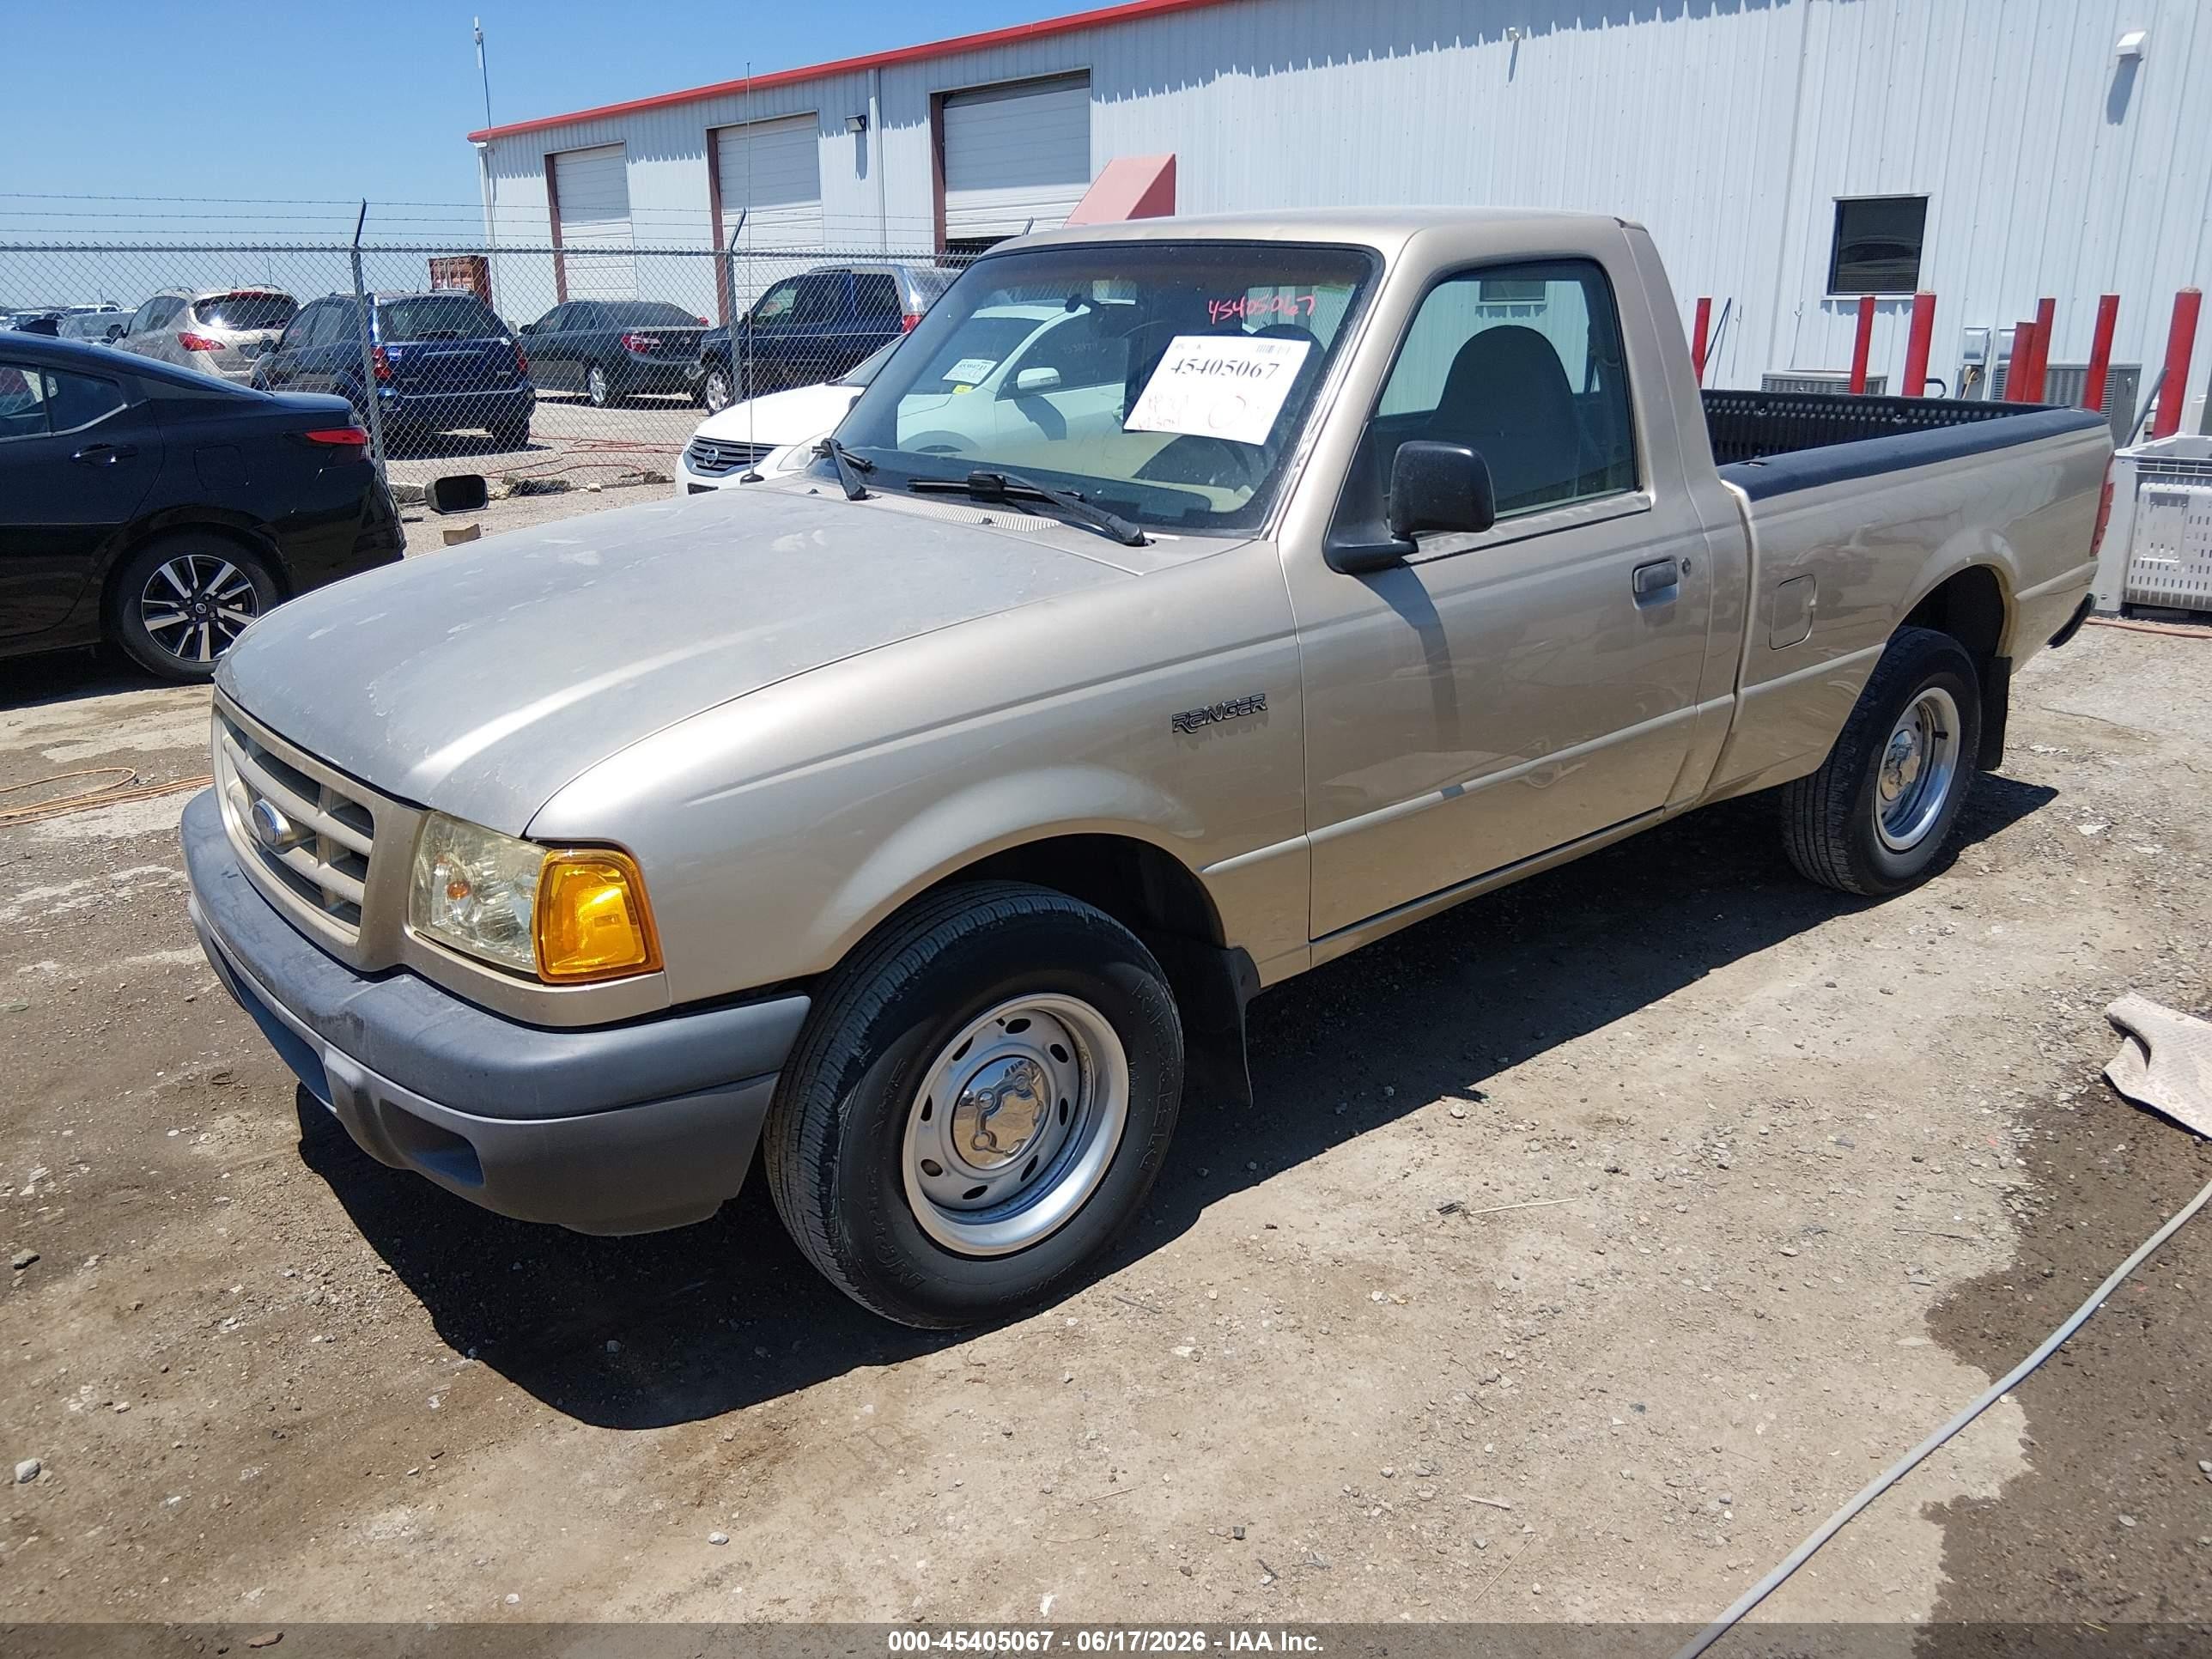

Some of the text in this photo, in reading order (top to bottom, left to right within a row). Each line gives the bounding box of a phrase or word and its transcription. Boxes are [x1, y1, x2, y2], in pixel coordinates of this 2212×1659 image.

[1209, 294, 1316, 324] 45405067
[1170, 357, 1280, 380] 45405067
[1172, 693, 1267, 733] RANGER
